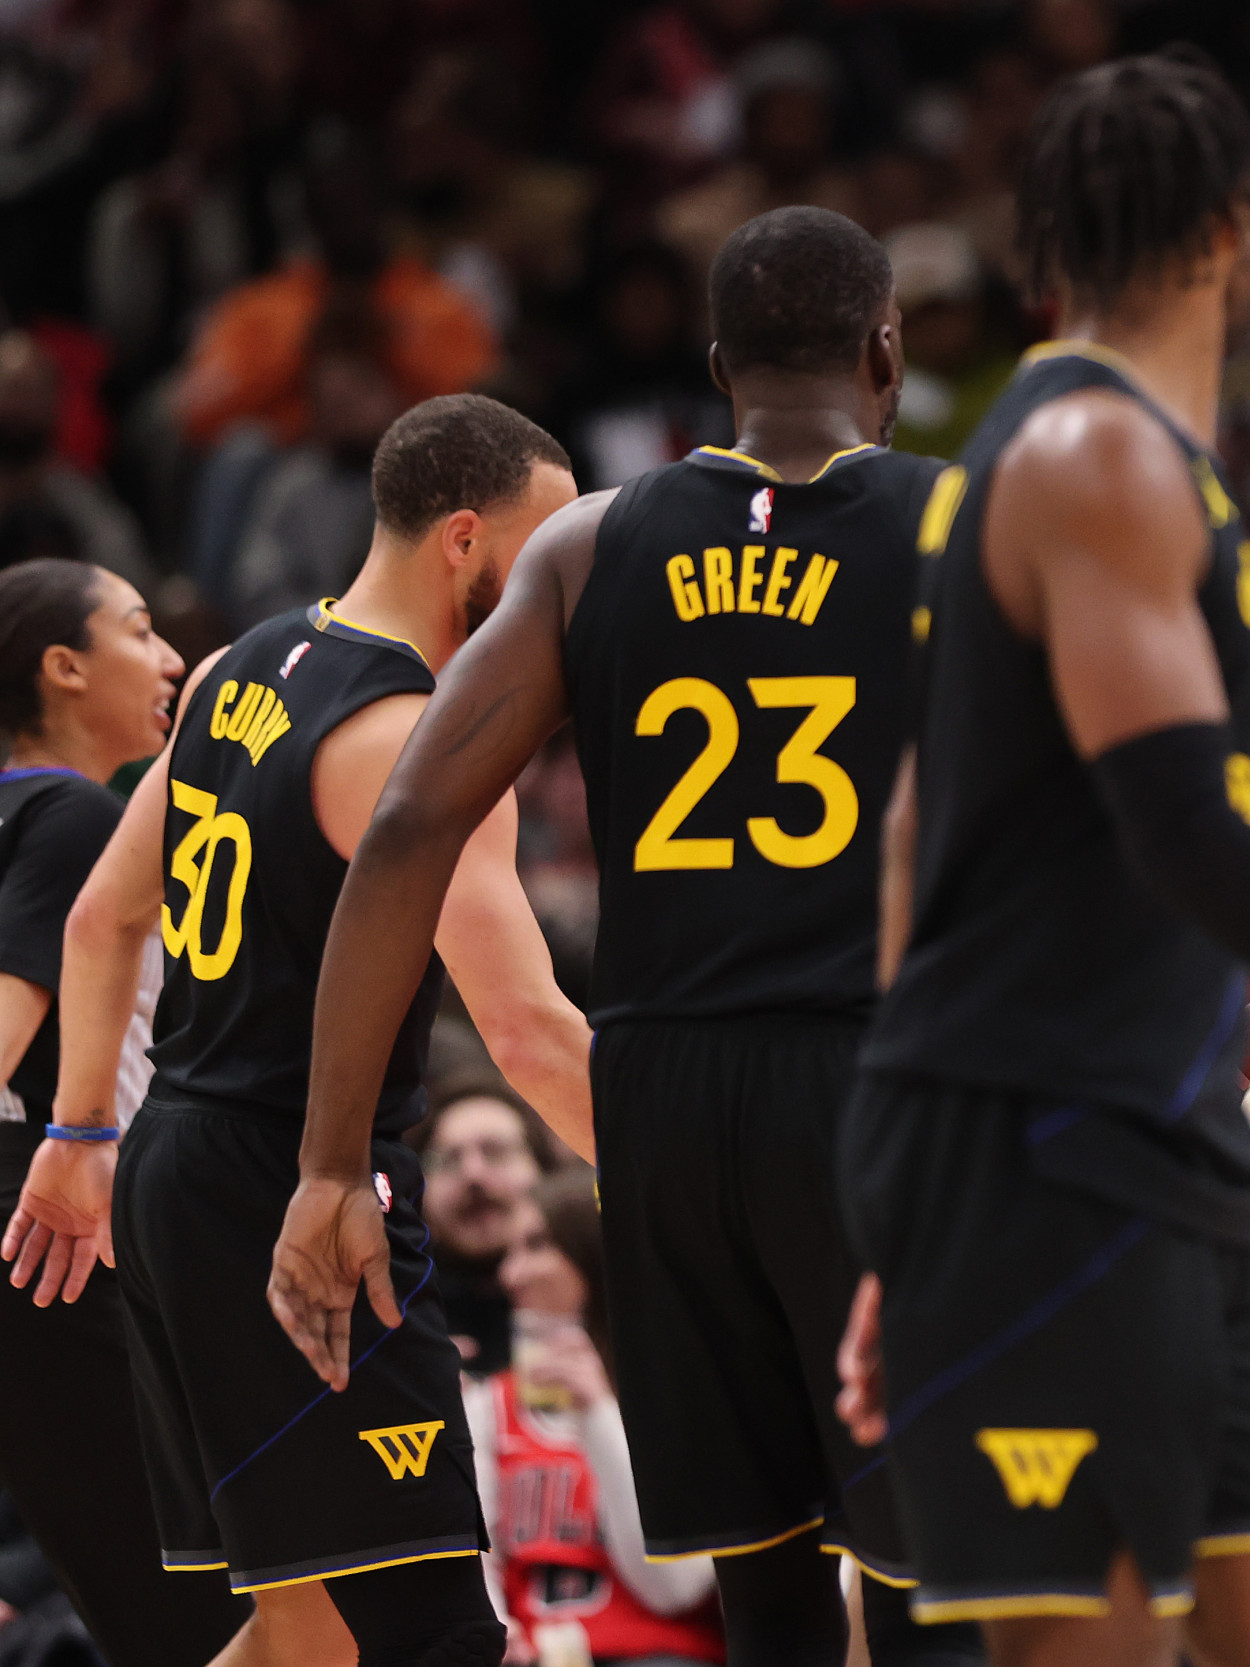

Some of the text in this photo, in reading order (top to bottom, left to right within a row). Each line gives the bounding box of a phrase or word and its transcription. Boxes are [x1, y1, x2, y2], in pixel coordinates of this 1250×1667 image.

[666, 545, 839, 626] GREEN
[209, 679, 292, 767] CURRY
[634, 675, 859, 872] 23
[161, 778, 253, 981] 30
